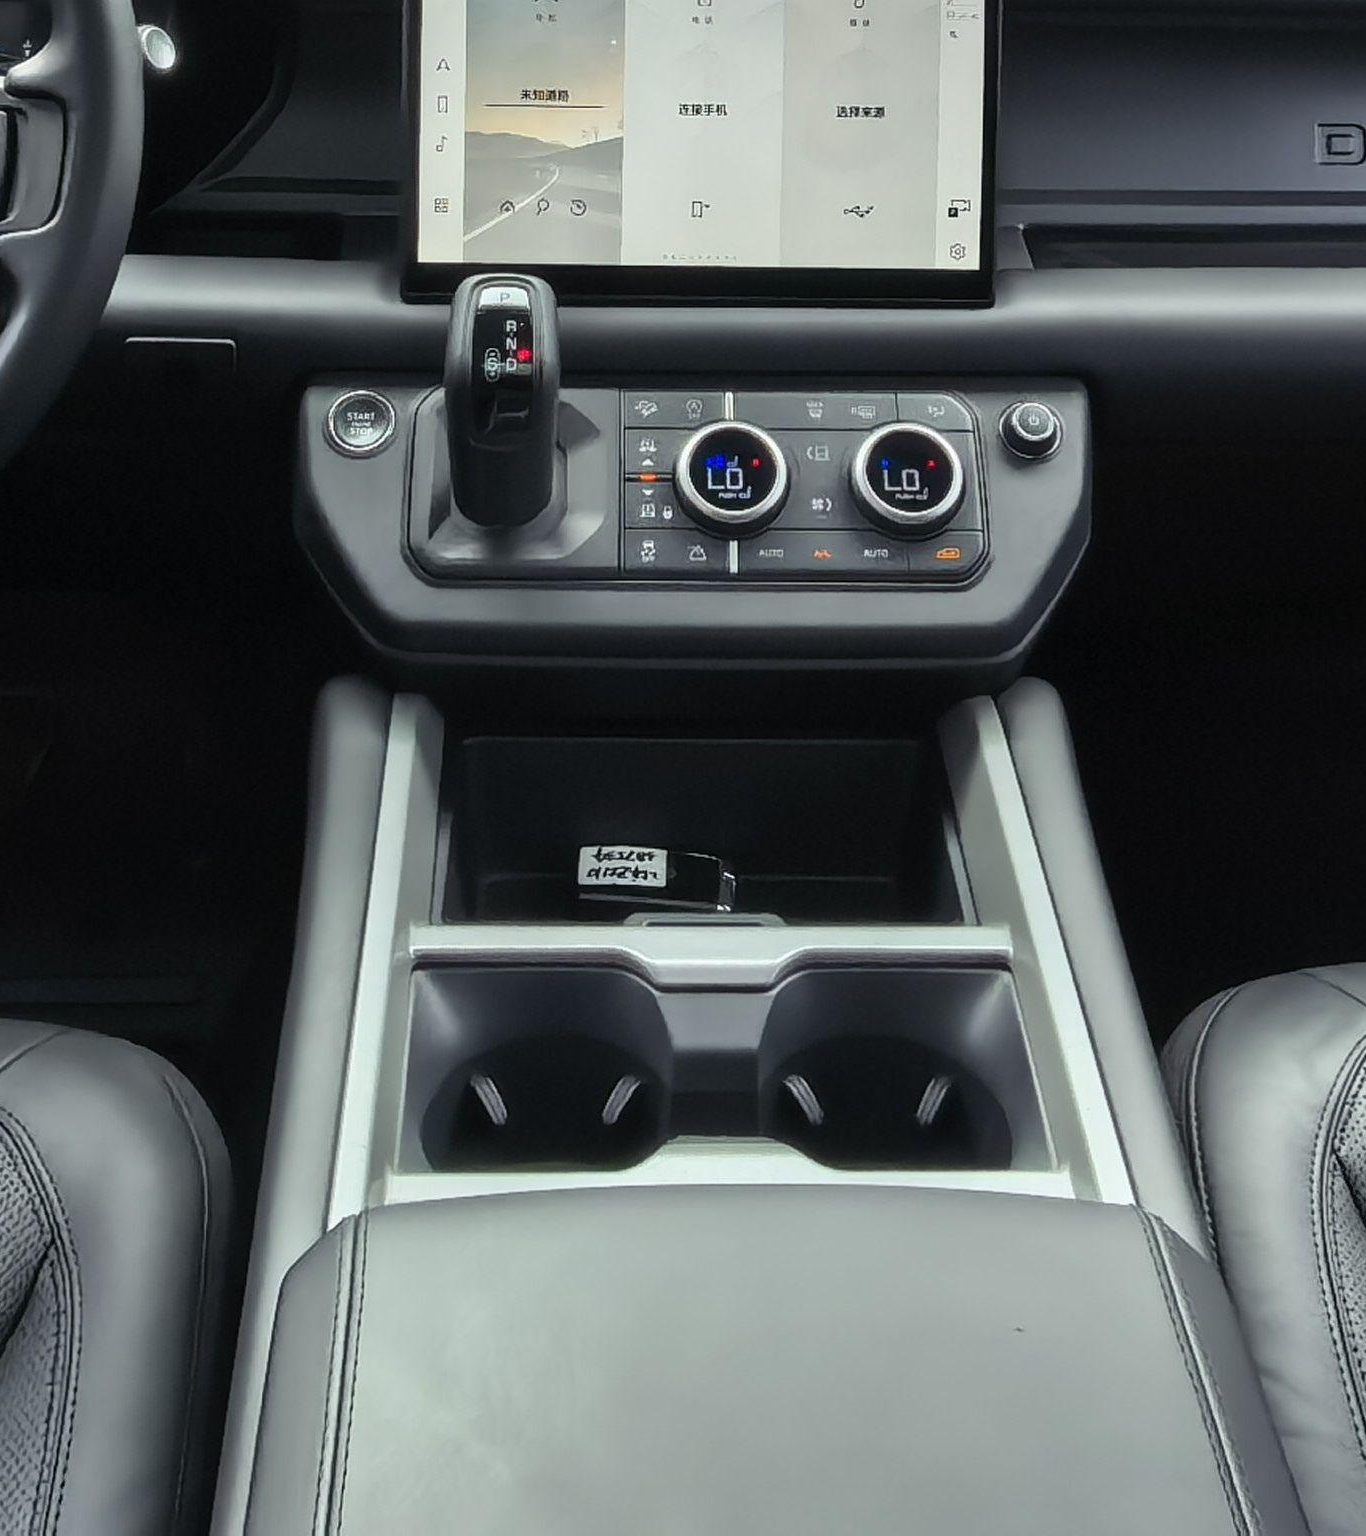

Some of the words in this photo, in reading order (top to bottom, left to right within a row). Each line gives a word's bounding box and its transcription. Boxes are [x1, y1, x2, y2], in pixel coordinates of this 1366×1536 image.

[520, 89, 569, 102] 未知道路
[678, 103, 728, 117] 连接手机
[836, 106, 885, 119] 选择来源
[499, 292, 511, 303] P
[505, 320, 517, 333] R
[505, 337, 517, 351] N
[505, 357, 517, 373] D
[347, 411, 375, 421] START
[350, 427, 373, 435] STOP
[883, 469, 920, 491] LO
[759, 549, 784, 558] AUTO
[863, 549, 889, 558] AUTO
